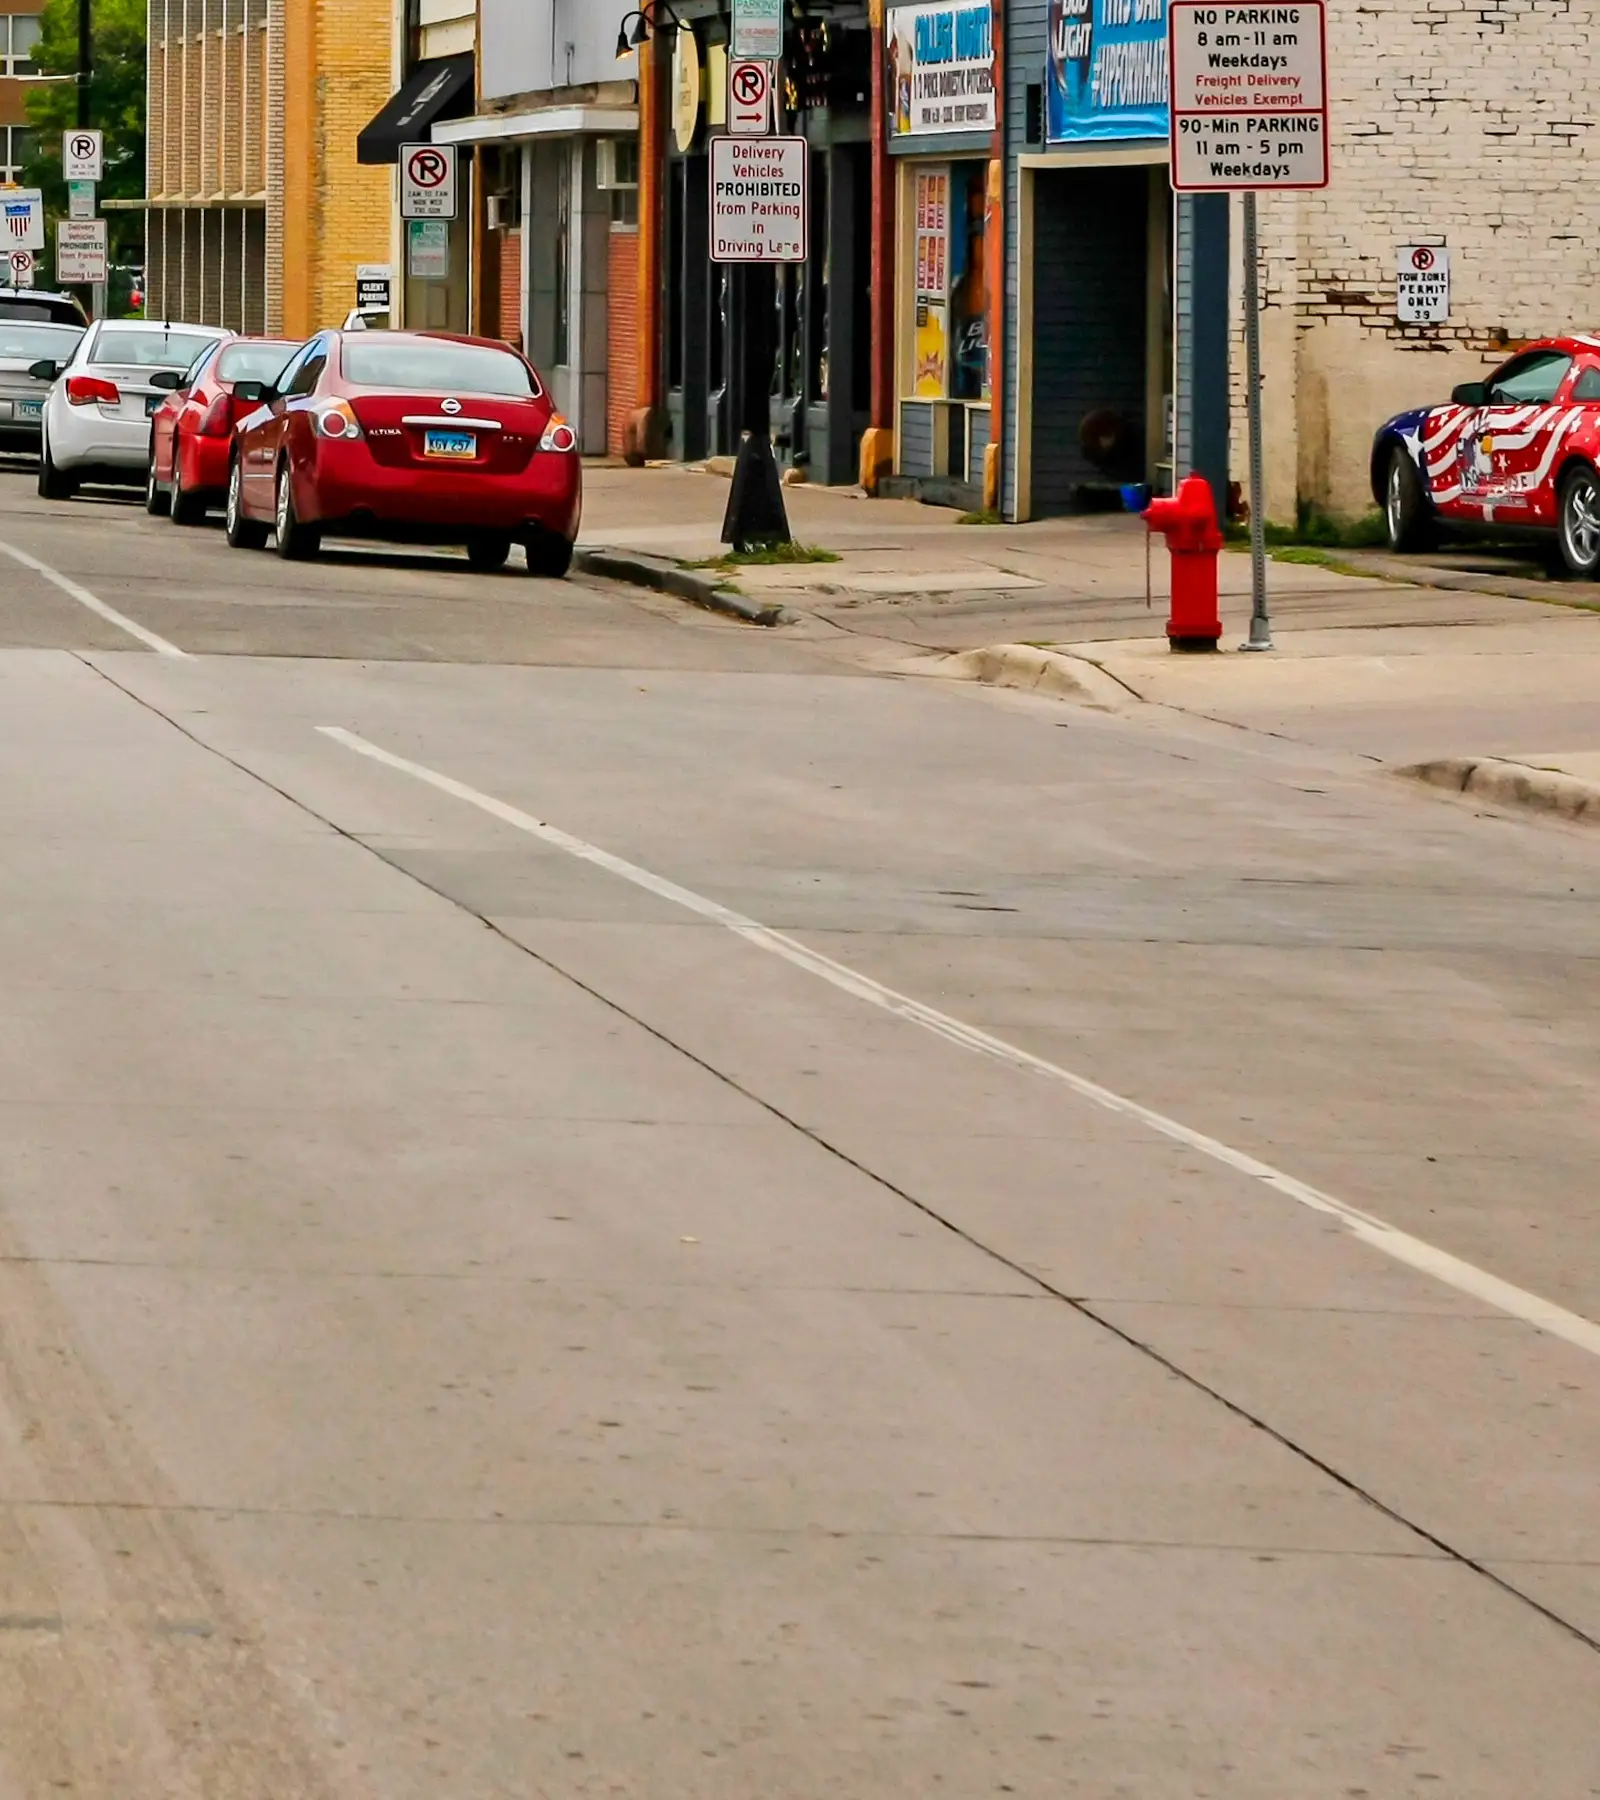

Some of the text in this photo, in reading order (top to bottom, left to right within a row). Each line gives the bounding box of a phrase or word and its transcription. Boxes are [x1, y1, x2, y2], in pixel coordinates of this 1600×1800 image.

[1194, 9, 1300, 25] NO PARKING
[1057, 19, 1093, 60] LIGHT
[1197, 32, 1208, 46] 8
[1273, 34, 1297, 45] am
[1208, 53, 1287, 70] Weekdays
[1196, 74, 1301, 90] Freight Delivery
[1195, 93, 1303, 107] Vehicles Exempt
[1179, 118, 1319, 133] 90-Min PARKING
[732, 145, 785, 163] Delivery
[1196, 141, 1208, 155] 11
[1215, 143, 1240, 155] am
[1260, 140, 1270, 154] 5
[1278, 142, 1303, 157] pm
[732, 164, 784, 178] Vehicles
[1210, 162, 1290, 179] Weekdays
[716, 183, 800, 197] PROHIBITED
[716, 202, 800, 219] from Parking
[753, 221, 764, 234] in
[60, 242, 103, 250] PROHIBITED
[718, 239, 763, 257] Driving
[1397, 273, 1445, 281] TOW ZONE
[1400, 285, 1446, 294] PERMIT
[1408, 297, 1438, 306] ONLY
[1414, 310, 1430, 319] 39
[369, 428, 402, 436] ALTIMA
[451, 439, 471, 451] 257
